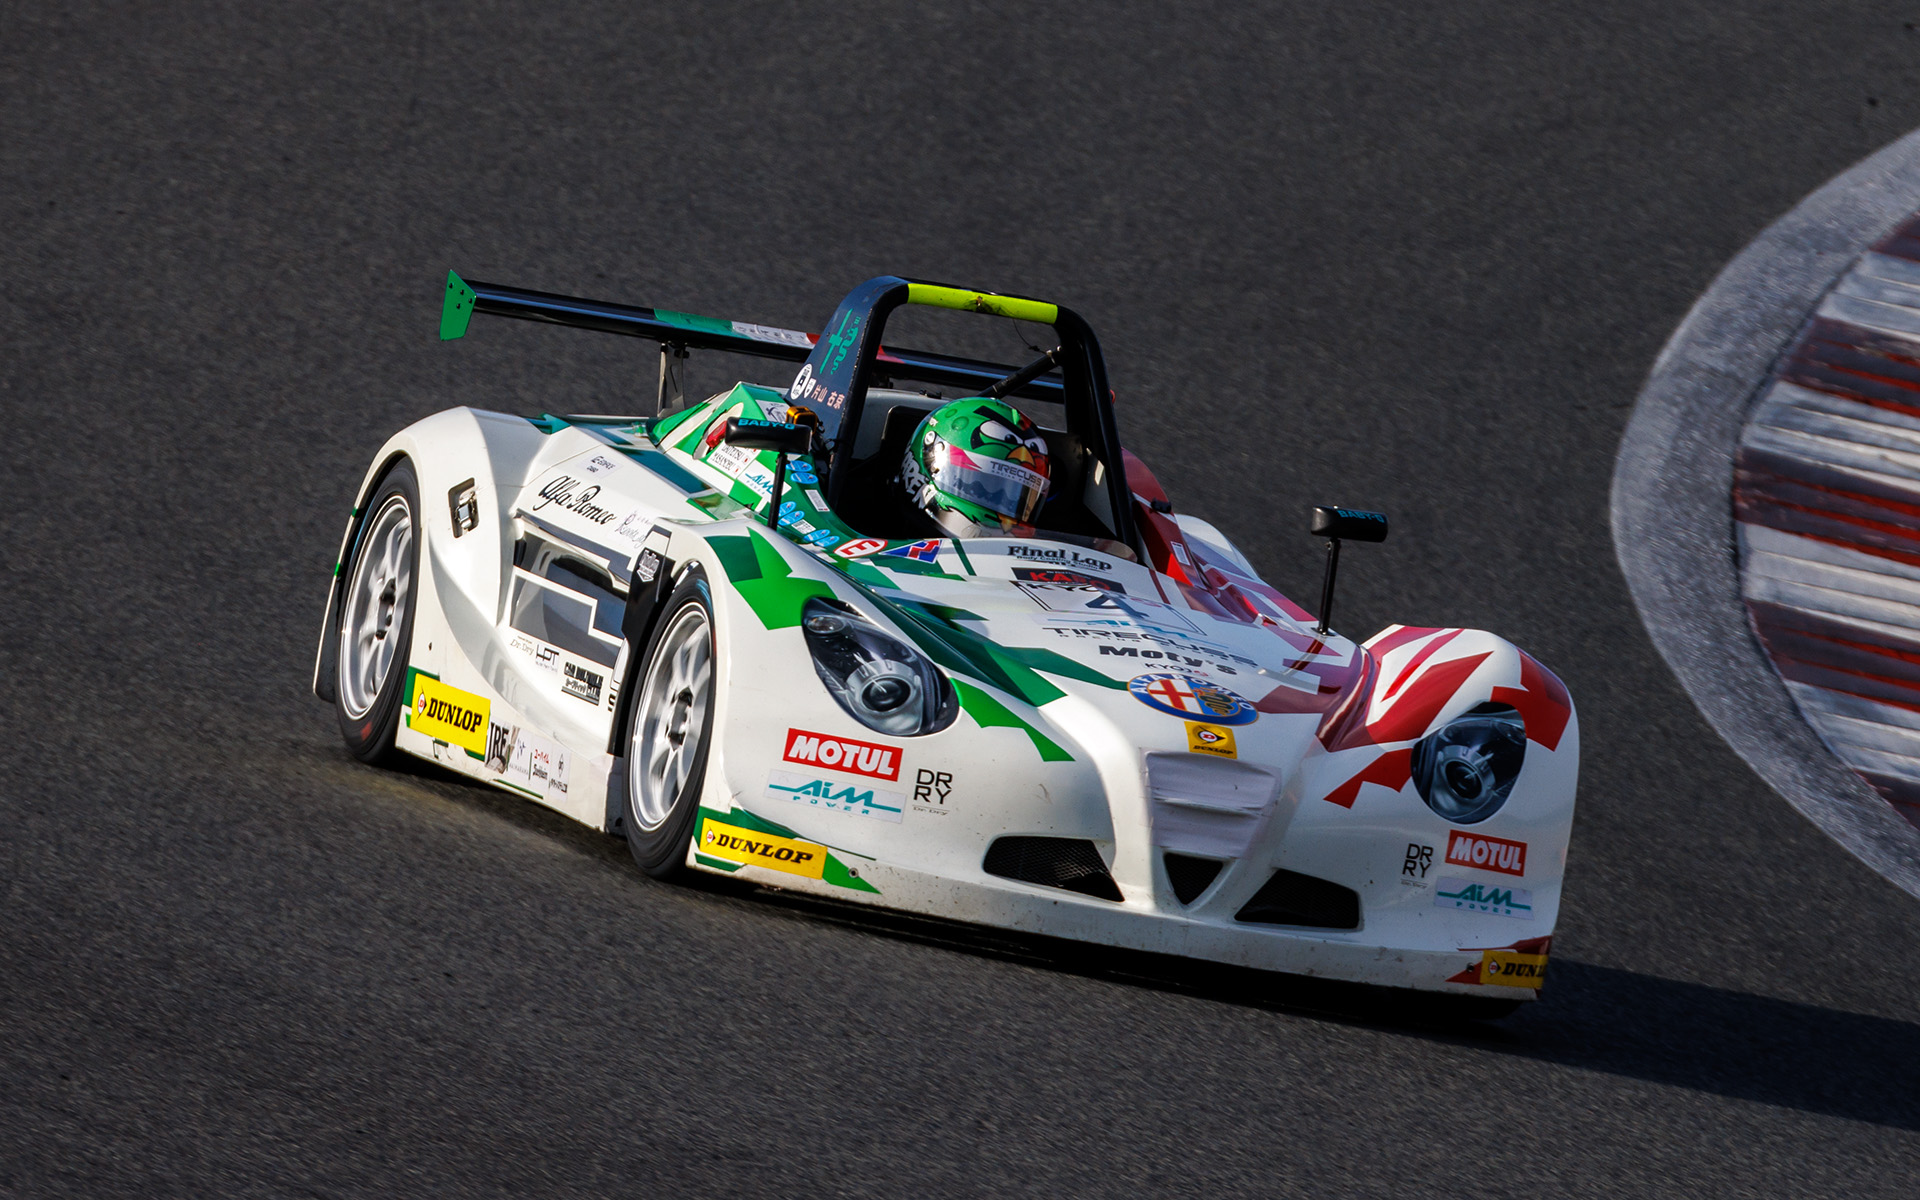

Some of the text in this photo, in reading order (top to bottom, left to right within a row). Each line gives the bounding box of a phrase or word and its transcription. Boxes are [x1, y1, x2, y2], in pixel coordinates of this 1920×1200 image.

[811, 384, 828, 403] 片山
[737, 418, 796, 430] BABY-G
[533, 475, 616, 525] Alfa Romeo
[1007, 545, 1113, 570] Final Lap
[1099, 645, 1238, 676] Moty's
[427, 698, 483, 733] DUNLOP
[788, 735, 895, 776] MOTUL
[1193, 745, 1234, 755] DUNLOP
[793, 796, 870, 815] POWER
[717, 832, 814, 864] DUNLOP
[1449, 835, 1522, 871] MOTUL
